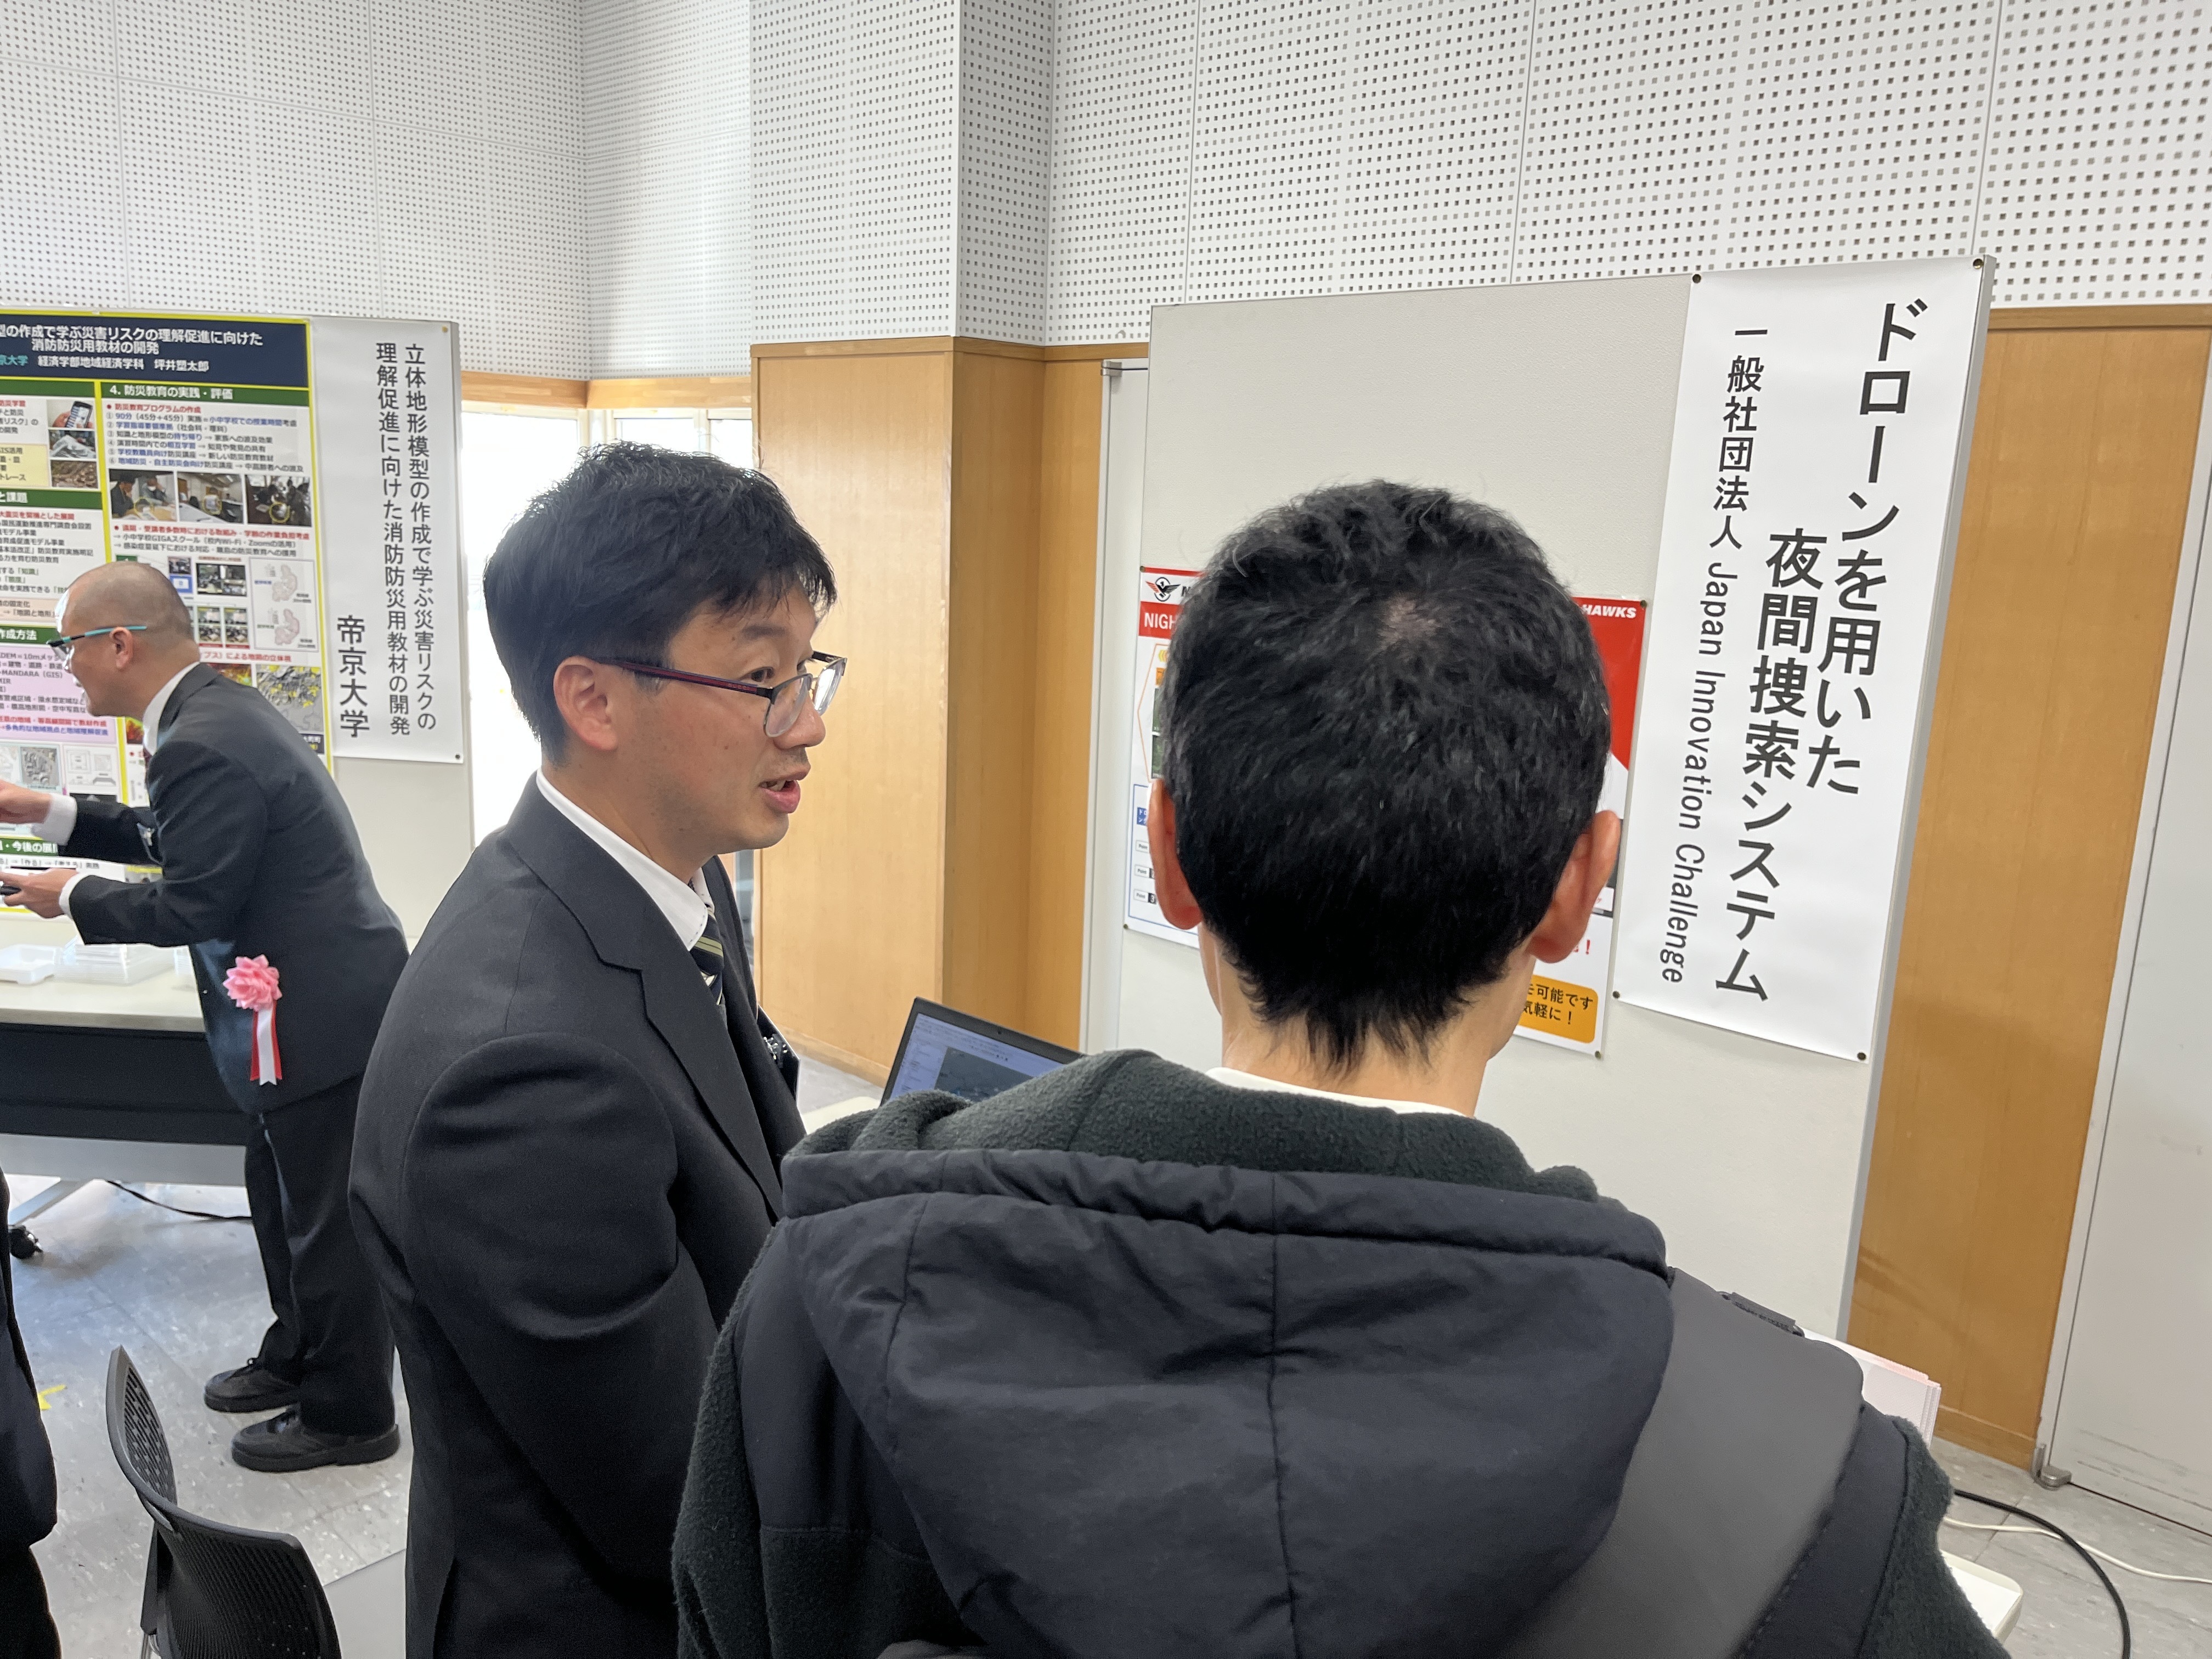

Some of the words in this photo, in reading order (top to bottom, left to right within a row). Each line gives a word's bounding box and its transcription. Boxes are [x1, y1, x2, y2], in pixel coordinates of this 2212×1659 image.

[31, 338, 160, 356] 消防防災用教材の開発
[1709, 329, 1768, 550] 一般社団法人
[375, 342, 410, 736] 理解促進に向けた消防防災用教材の開発
[404, 343, 437, 730] 立体地形模型の作成で学ぶ災害リスクの
[1699, 562, 1738, 656] Japan
[1807, 298, 1928, 794] ドローンを用いた
[336, 614, 370, 738] 帝京大学
[1679, 671, 1726, 830] Innovation
[1715, 527, 1827, 1002] 夜間捜索システム
[1660, 843, 1705, 984] Challenge
